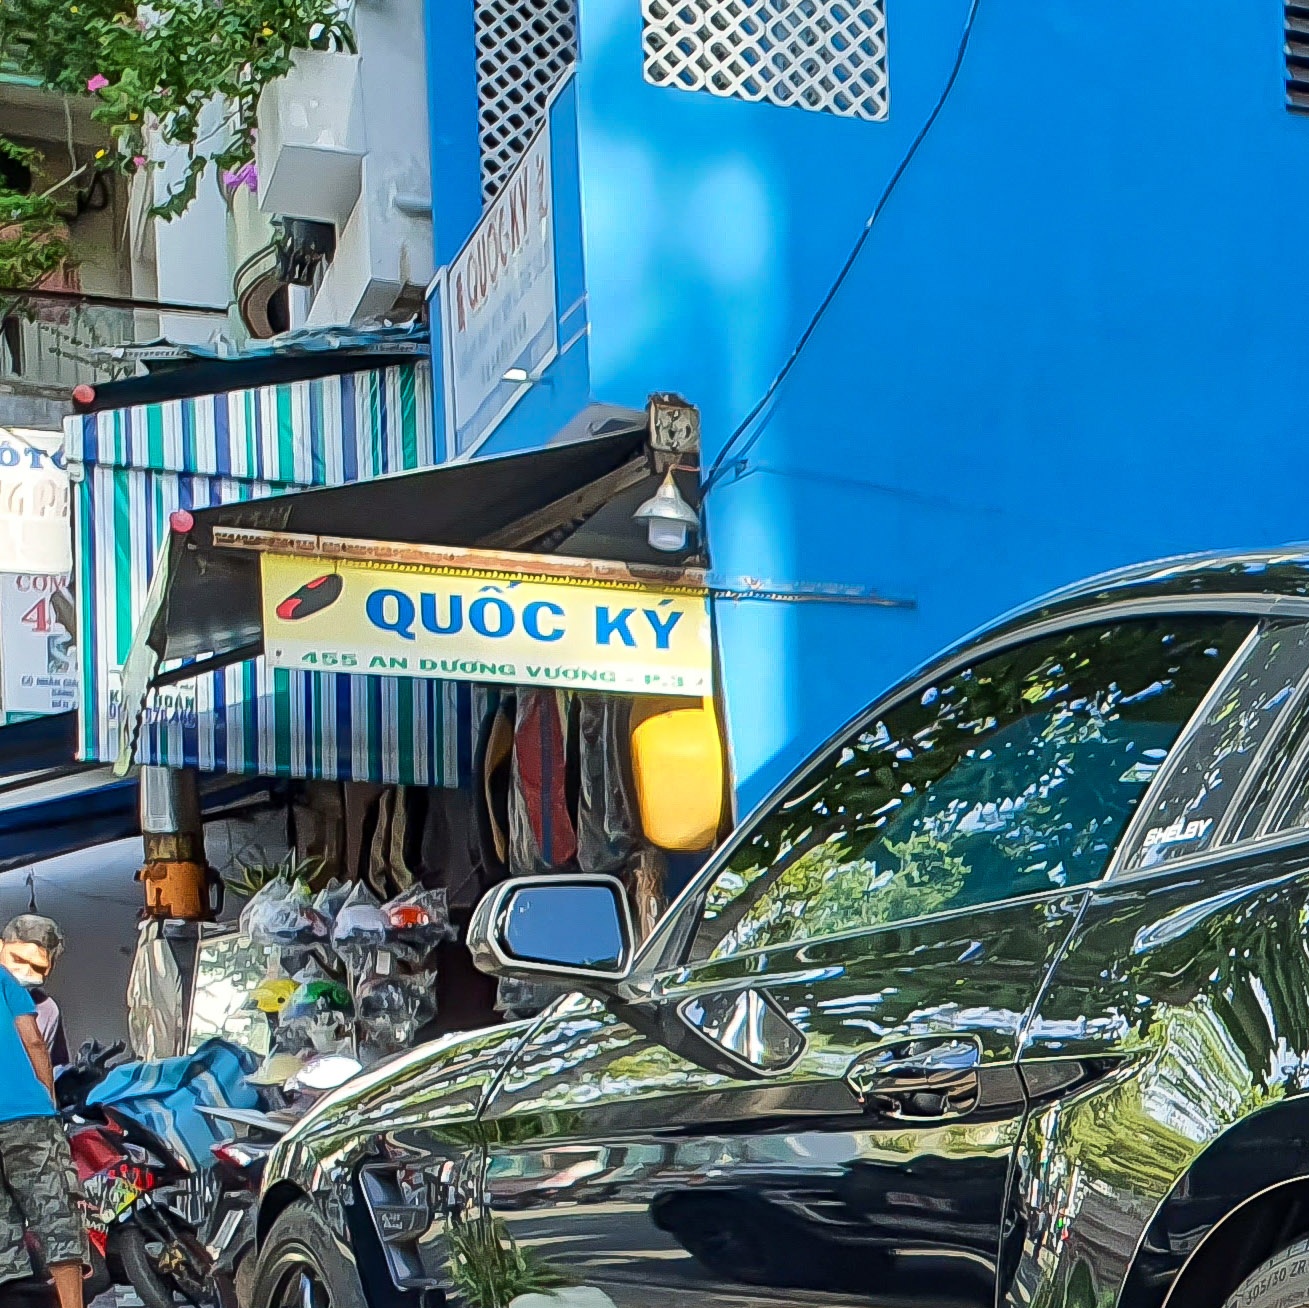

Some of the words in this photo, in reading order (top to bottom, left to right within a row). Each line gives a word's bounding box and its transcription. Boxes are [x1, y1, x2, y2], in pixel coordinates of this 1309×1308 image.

[366, 581, 566, 642] QUỐC
[594, 598, 685, 650] KÝ
[301, 651, 358, 667] 455
[368, 655, 408, 669] AN
[1143, 818, 1213, 847] SHELBY
